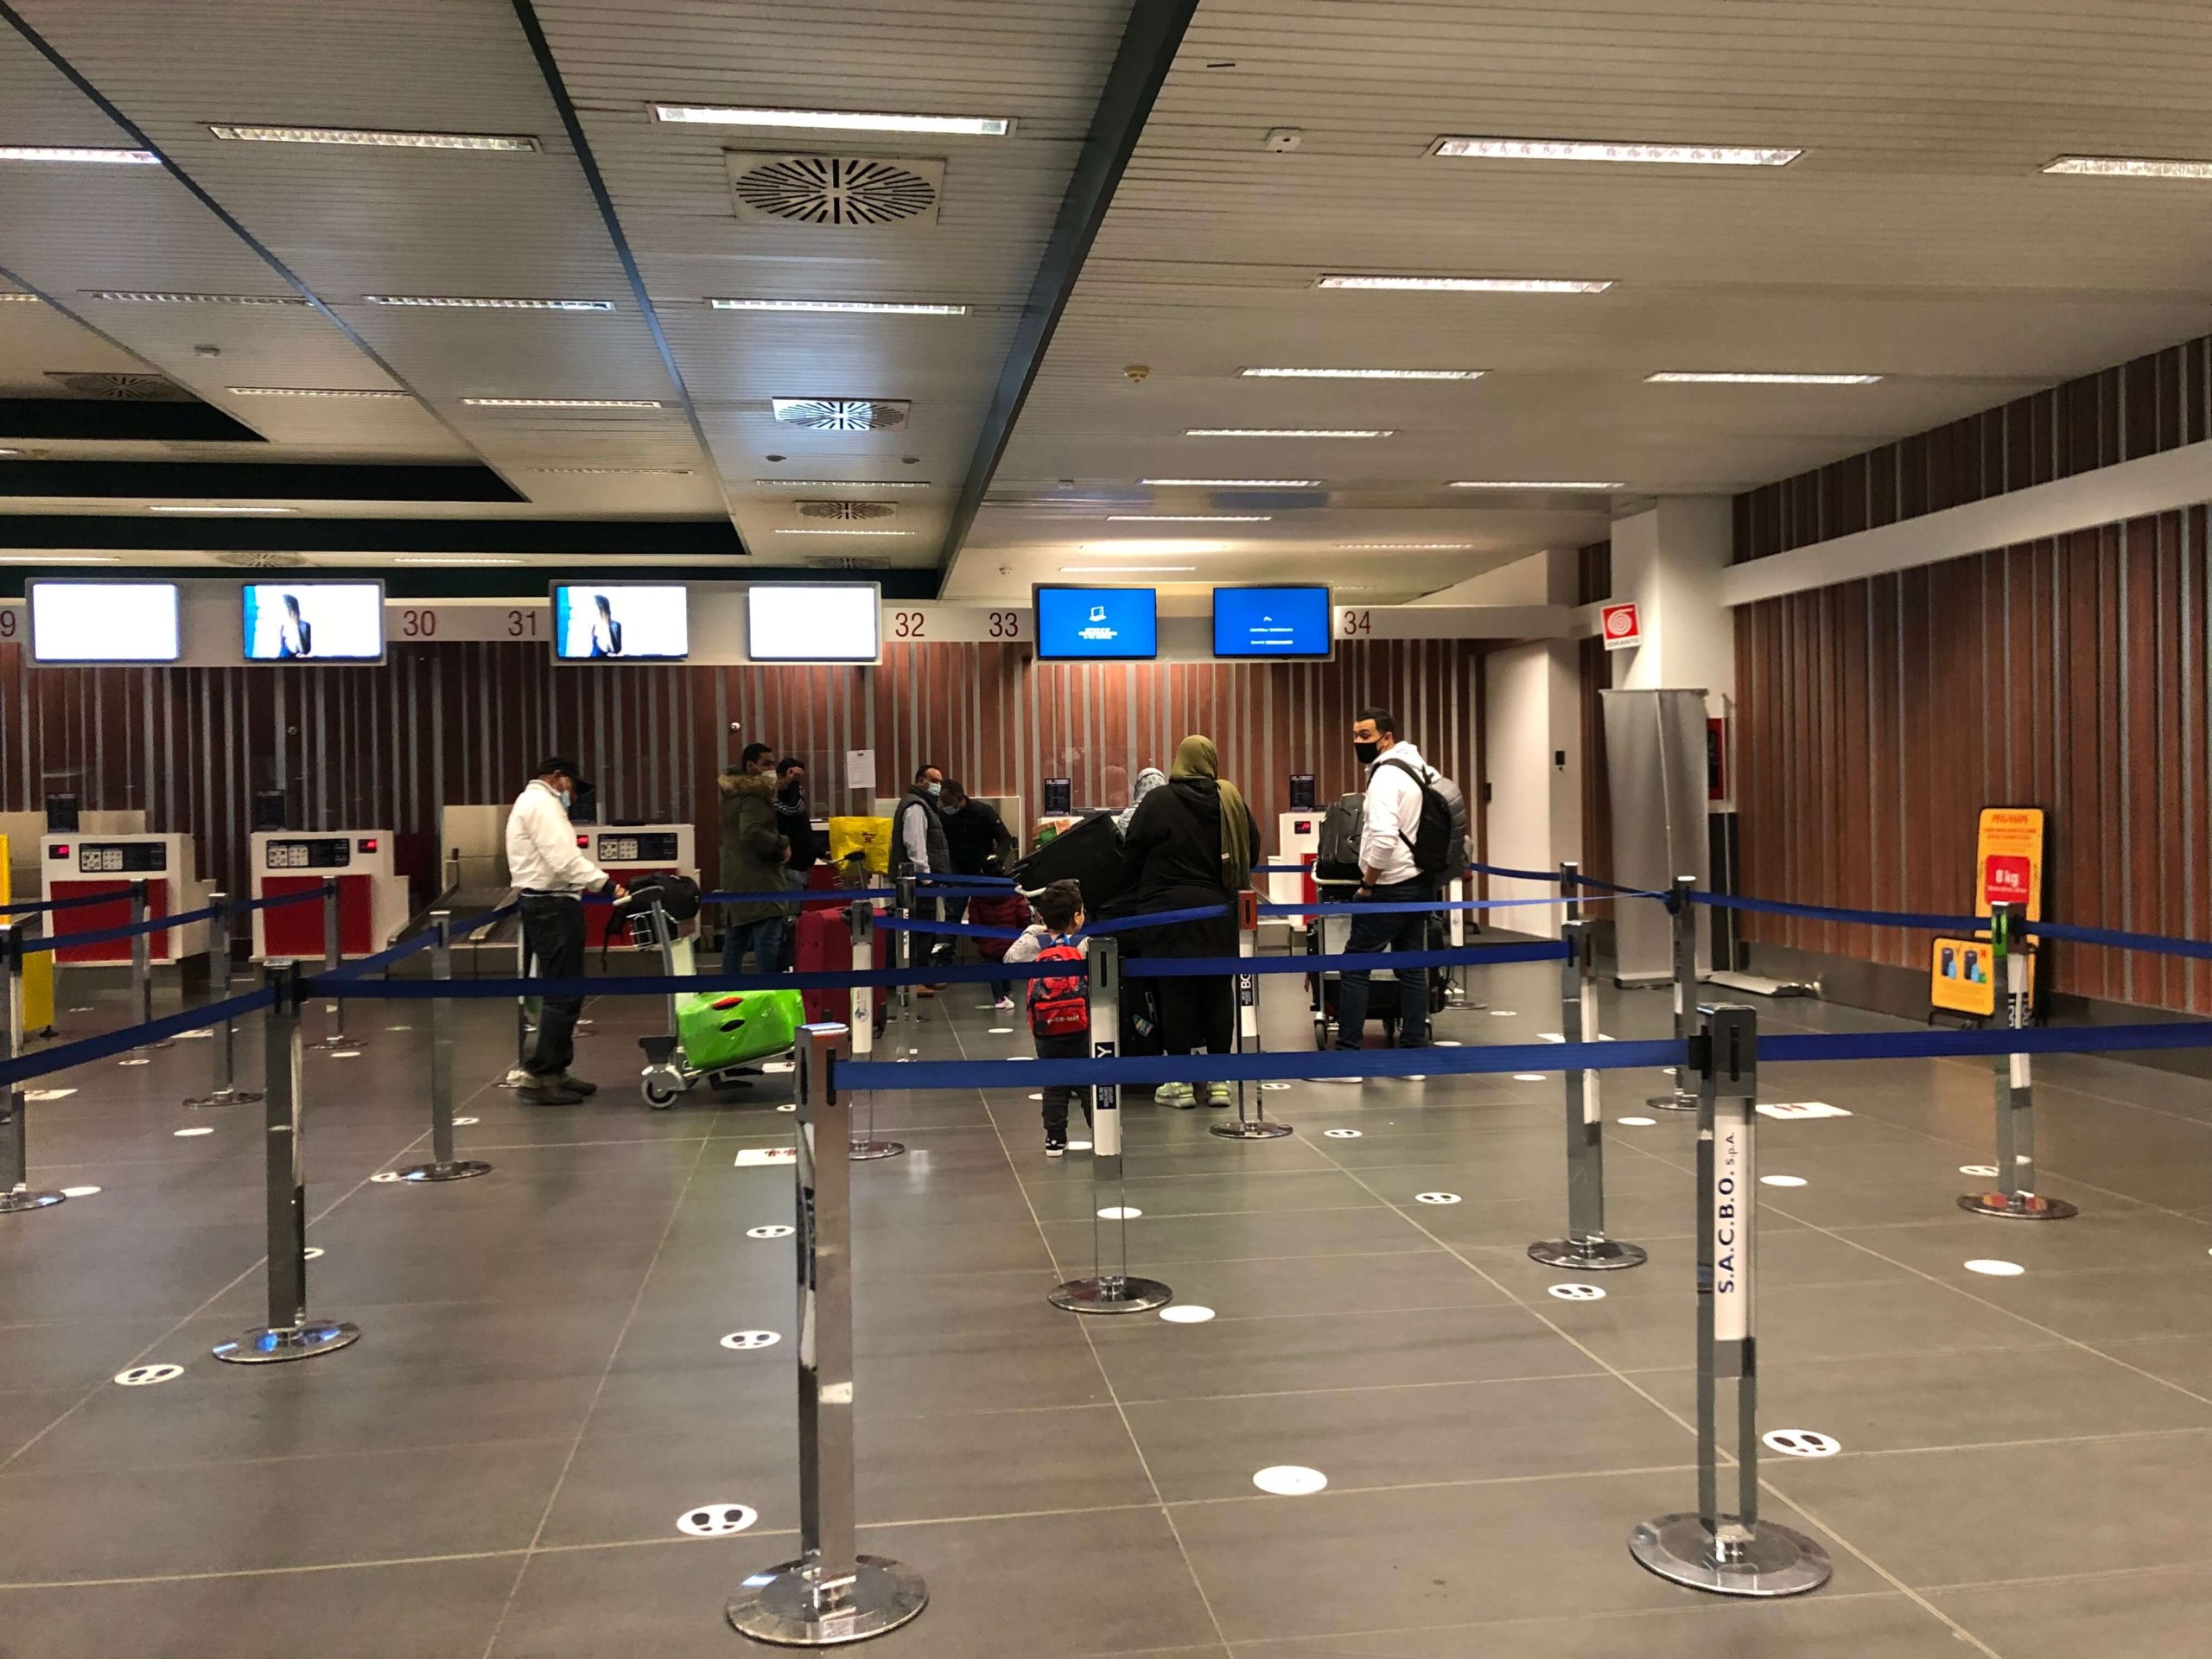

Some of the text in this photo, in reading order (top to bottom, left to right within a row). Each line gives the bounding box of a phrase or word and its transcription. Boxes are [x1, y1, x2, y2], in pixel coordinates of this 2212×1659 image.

[404, 610, 435, 637] 30
[508, 610, 537, 637] 31
[895, 612, 925, 637] 32
[988, 612, 1019, 637] 33
[1344, 610, 1372, 635] 34
[1995, 868, 2019, 887] 8 kg
[1718, 1131, 1738, 1294] S.A.C.B.O. S.p.A.
